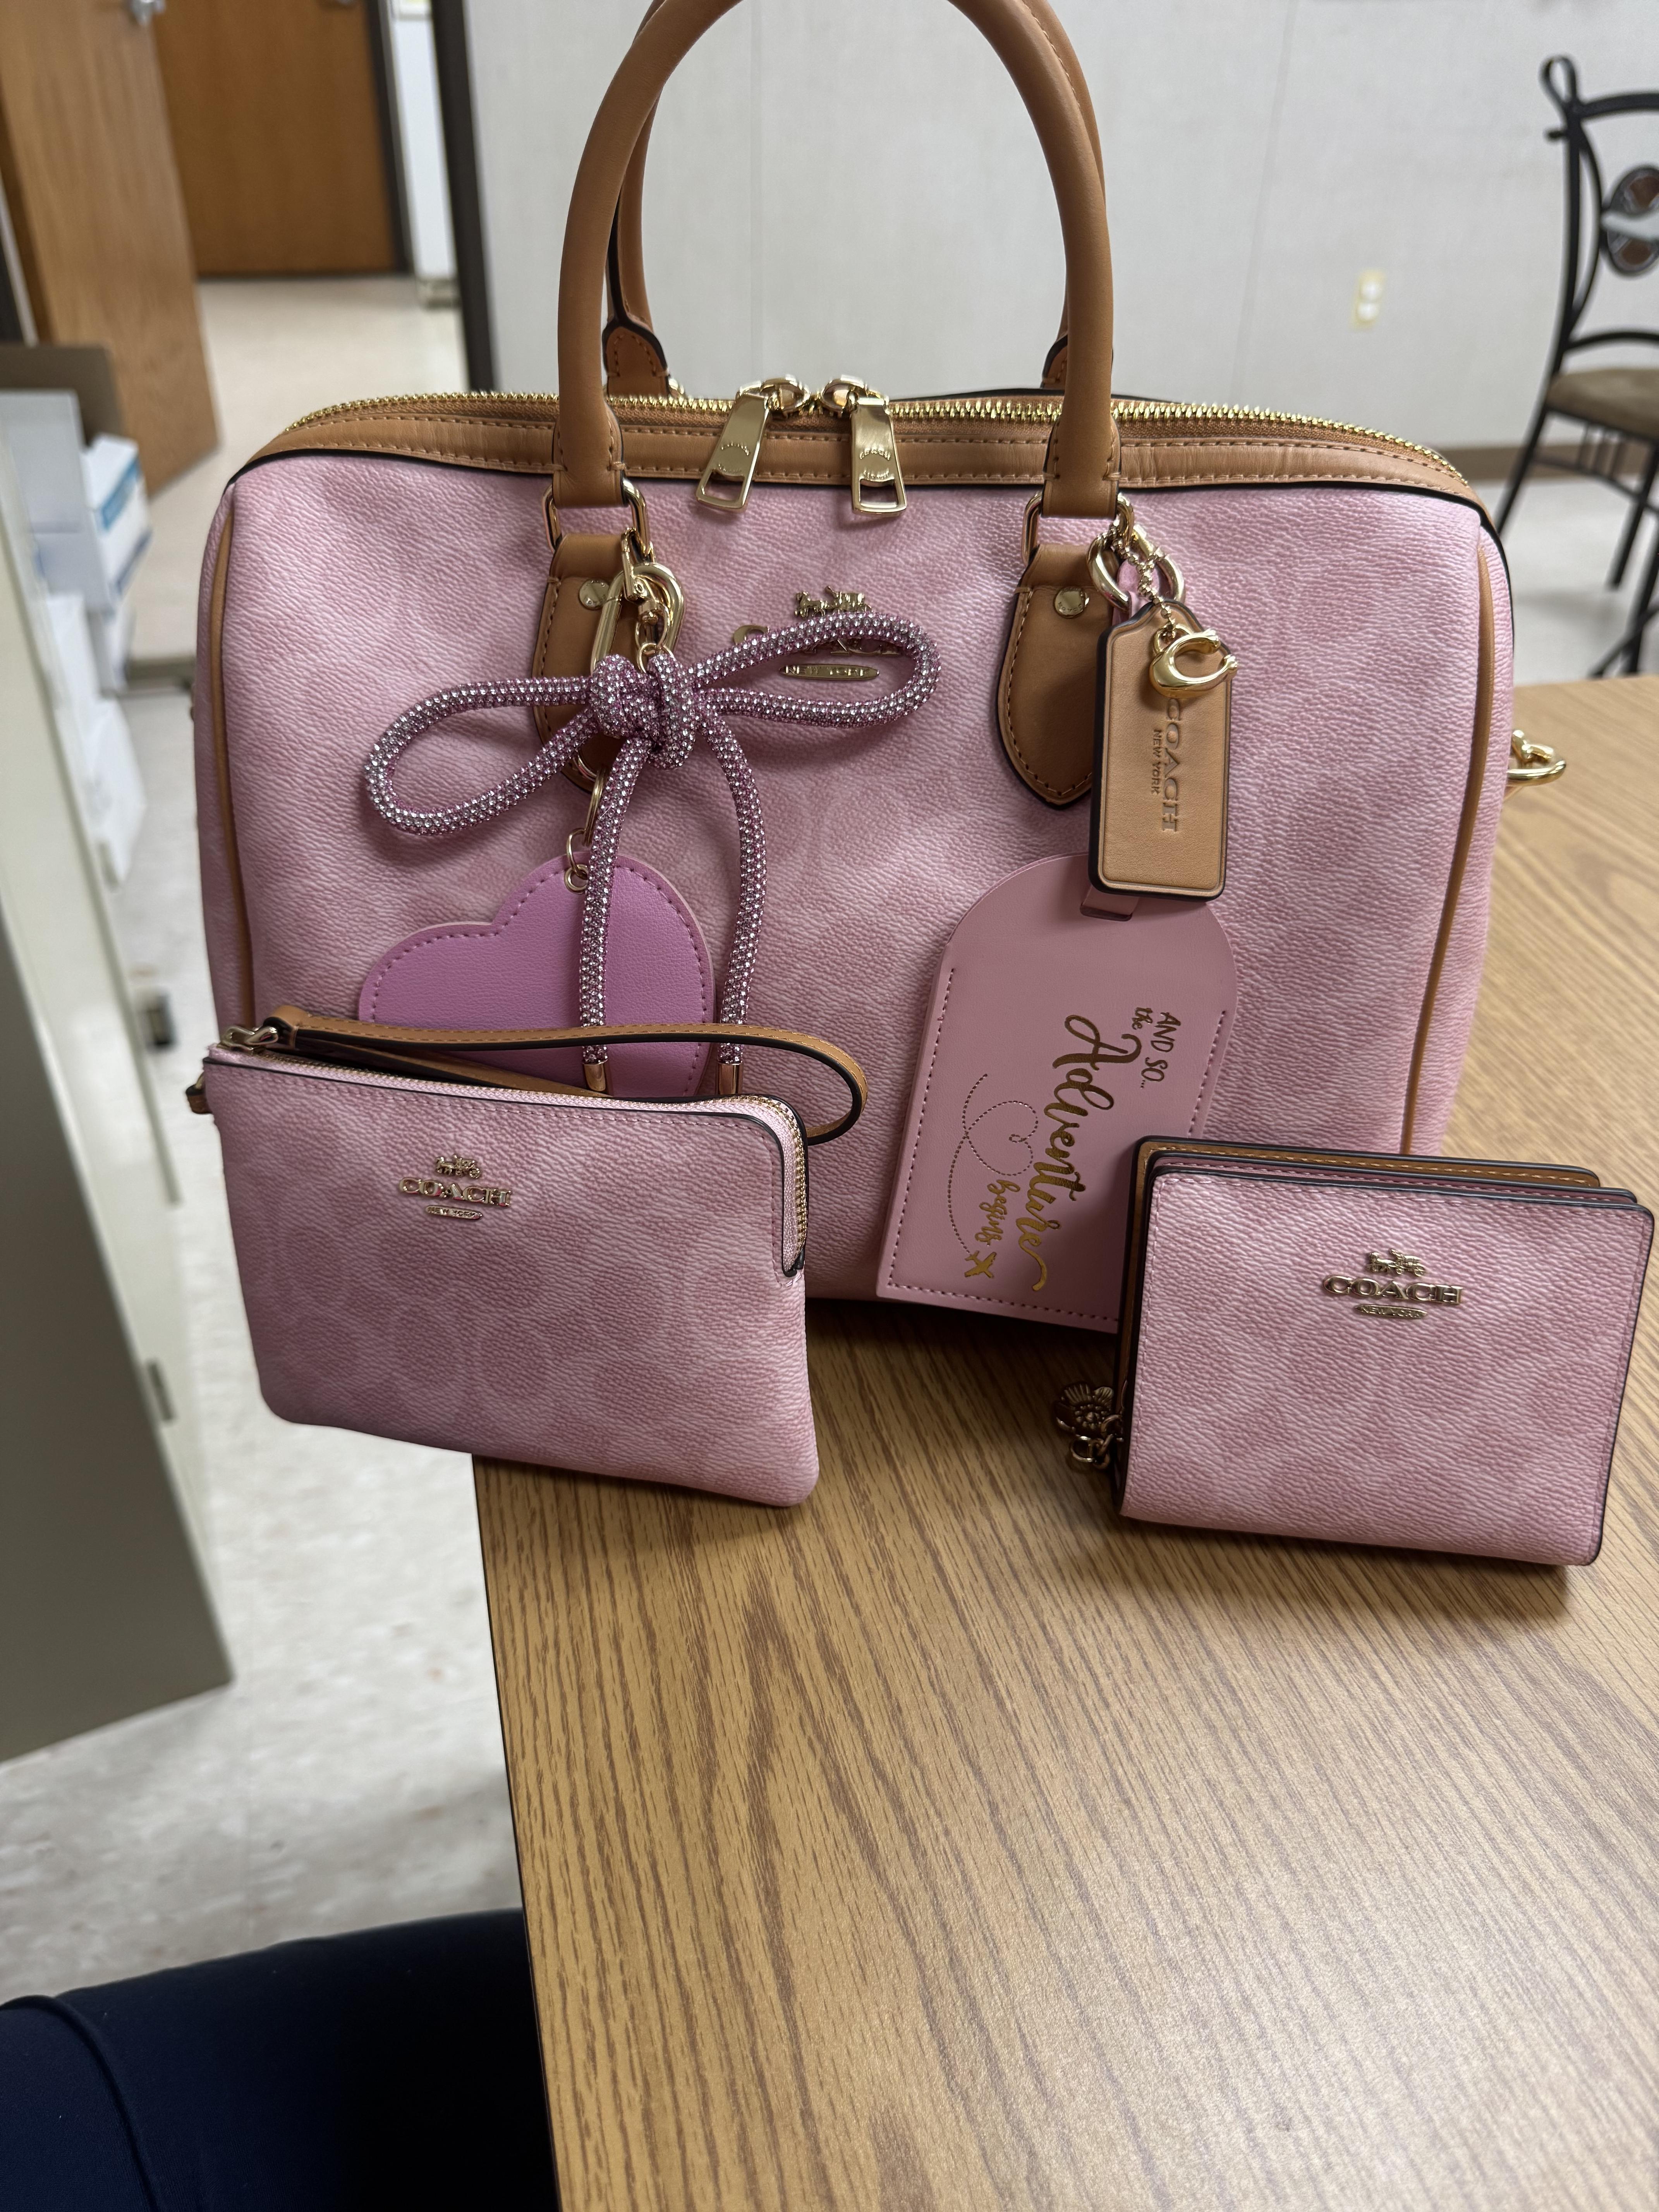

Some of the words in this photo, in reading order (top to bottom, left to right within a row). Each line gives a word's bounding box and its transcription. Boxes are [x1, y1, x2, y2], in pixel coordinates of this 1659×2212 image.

[1152, 729, 1163, 757] NEW
[1151, 761, 1161, 795] YORK
[1162, 698, 1181, 832] COACH
[1132, 1007, 1153, 1030] the
[1150, 1012, 1181, 1053] AND
[1015, 1014, 1142, 1291] Adventure
[399, 1177, 512, 1207] COACH
[427, 1206, 449, 1215] NEW
[974, 1179, 1021, 1246] begins
[1323, 1275, 1464, 1305] COACH
[1361, 1306, 1386, 1315] NEW
